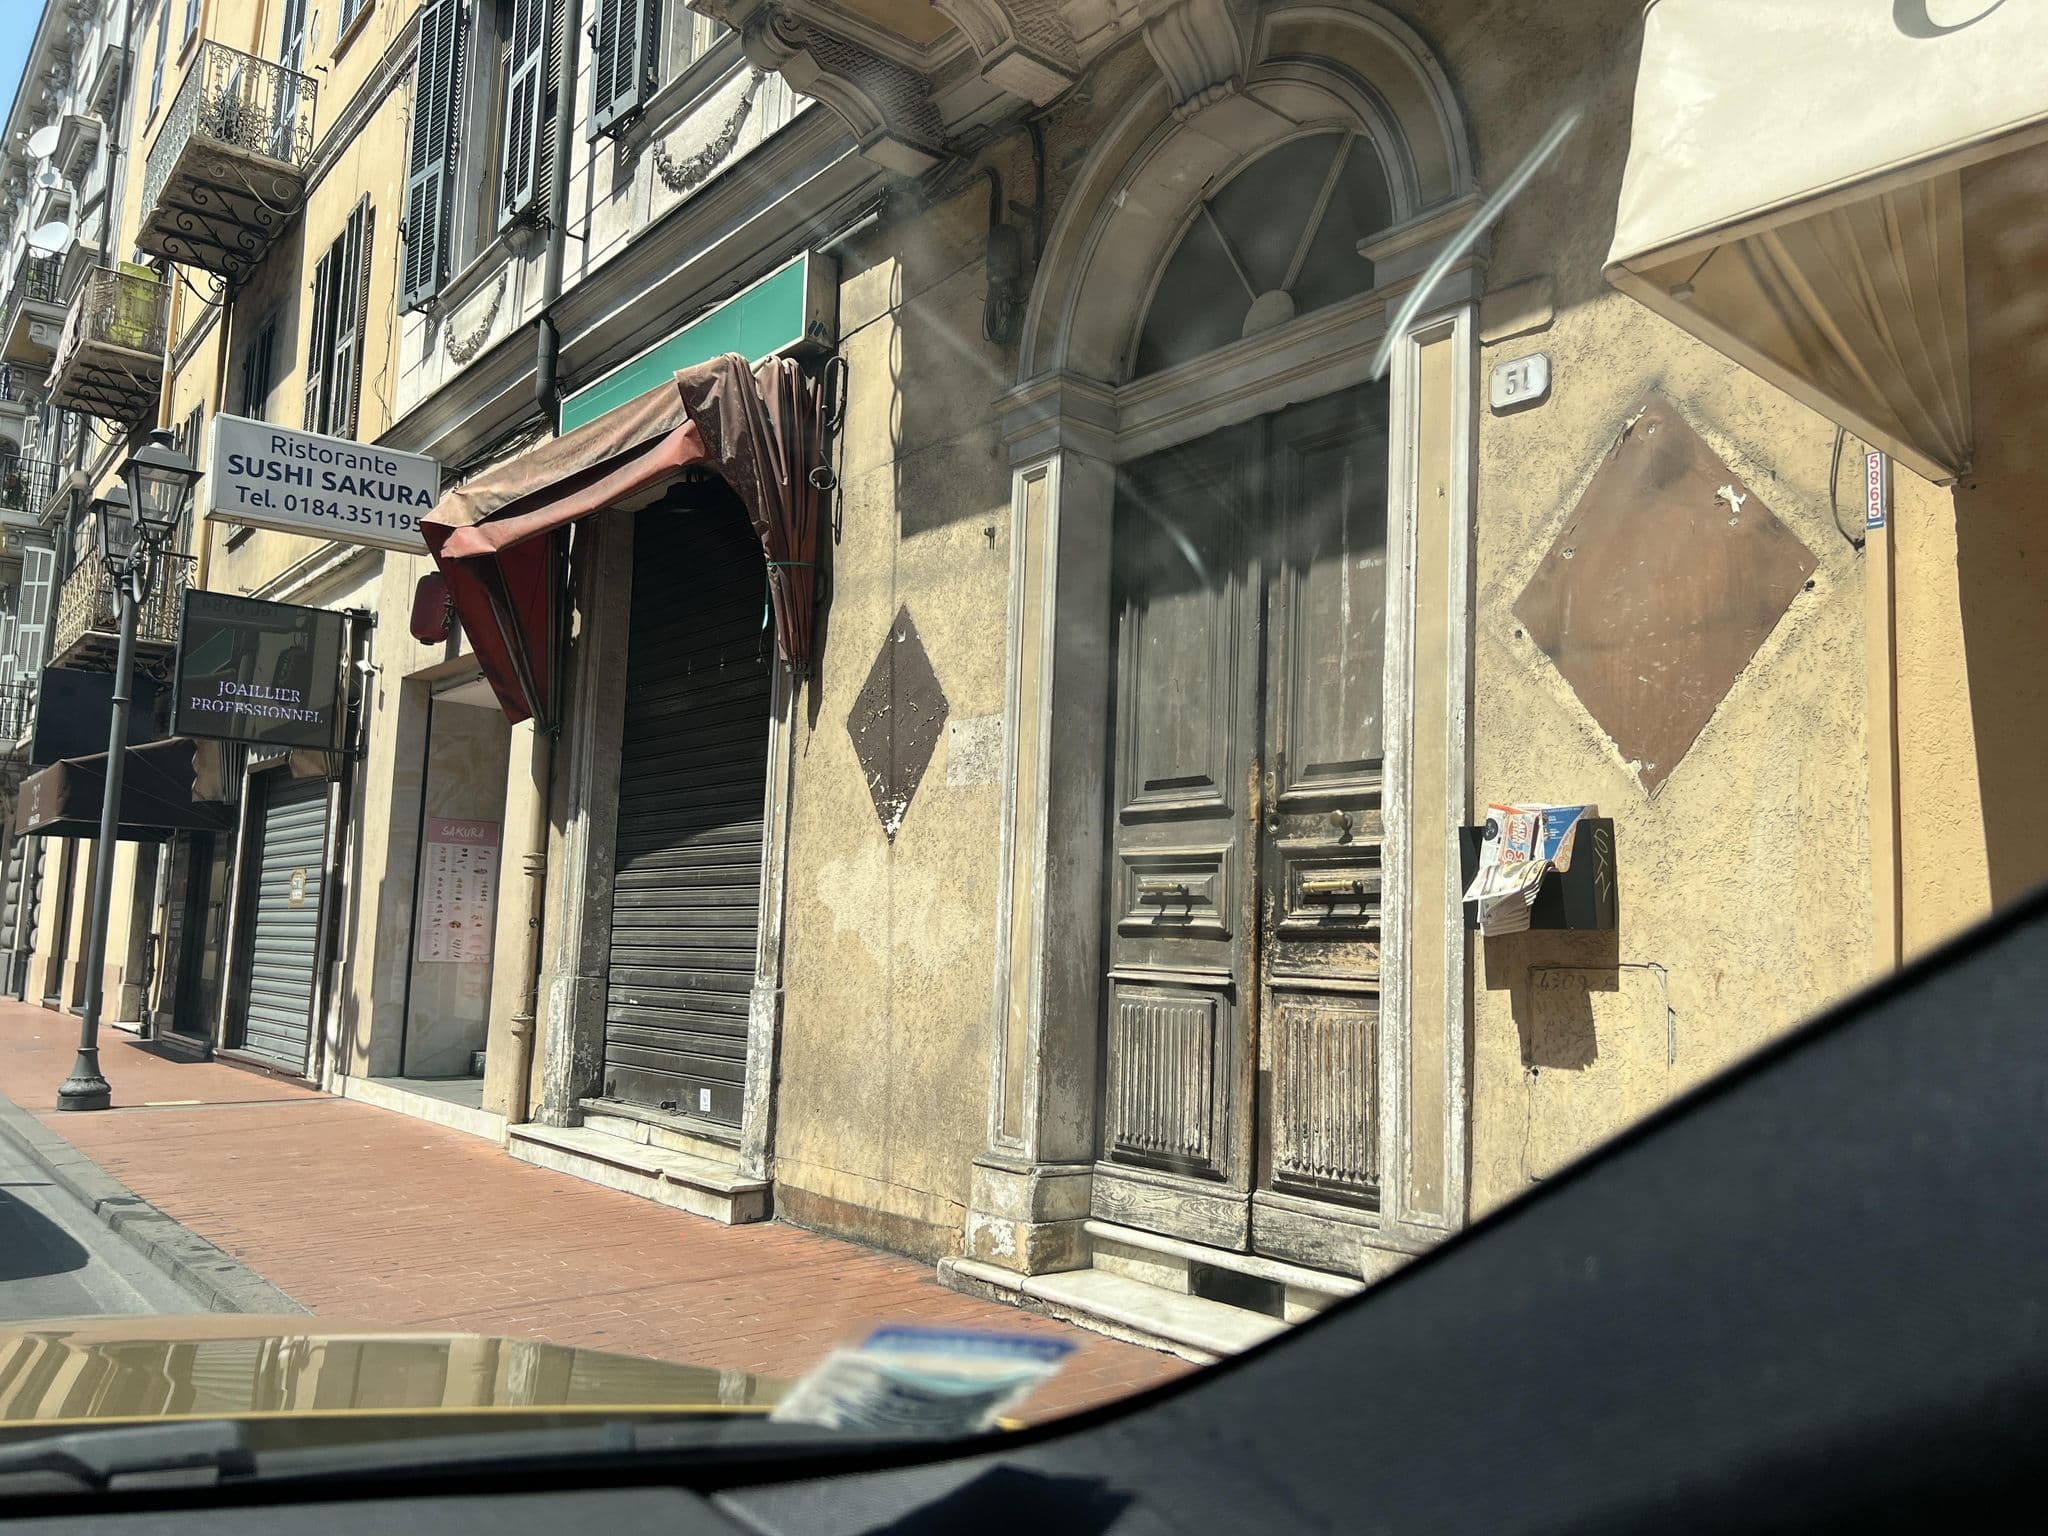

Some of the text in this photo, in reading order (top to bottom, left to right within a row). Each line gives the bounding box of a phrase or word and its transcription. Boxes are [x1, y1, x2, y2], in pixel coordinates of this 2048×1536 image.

[1505, 362, 1530, 396] 51
[271, 435, 398, 476] Ristorante
[227, 454, 433, 509] SUSHI SAKURA
[235, 485, 277, 508] Tel.
[1869, 454, 1880, 517] 5865
[217, 680, 301, 703] JOAILLIER
[190, 696, 323, 724] PROFESSIONNEL
[440, 825, 485, 839] SAKURA
